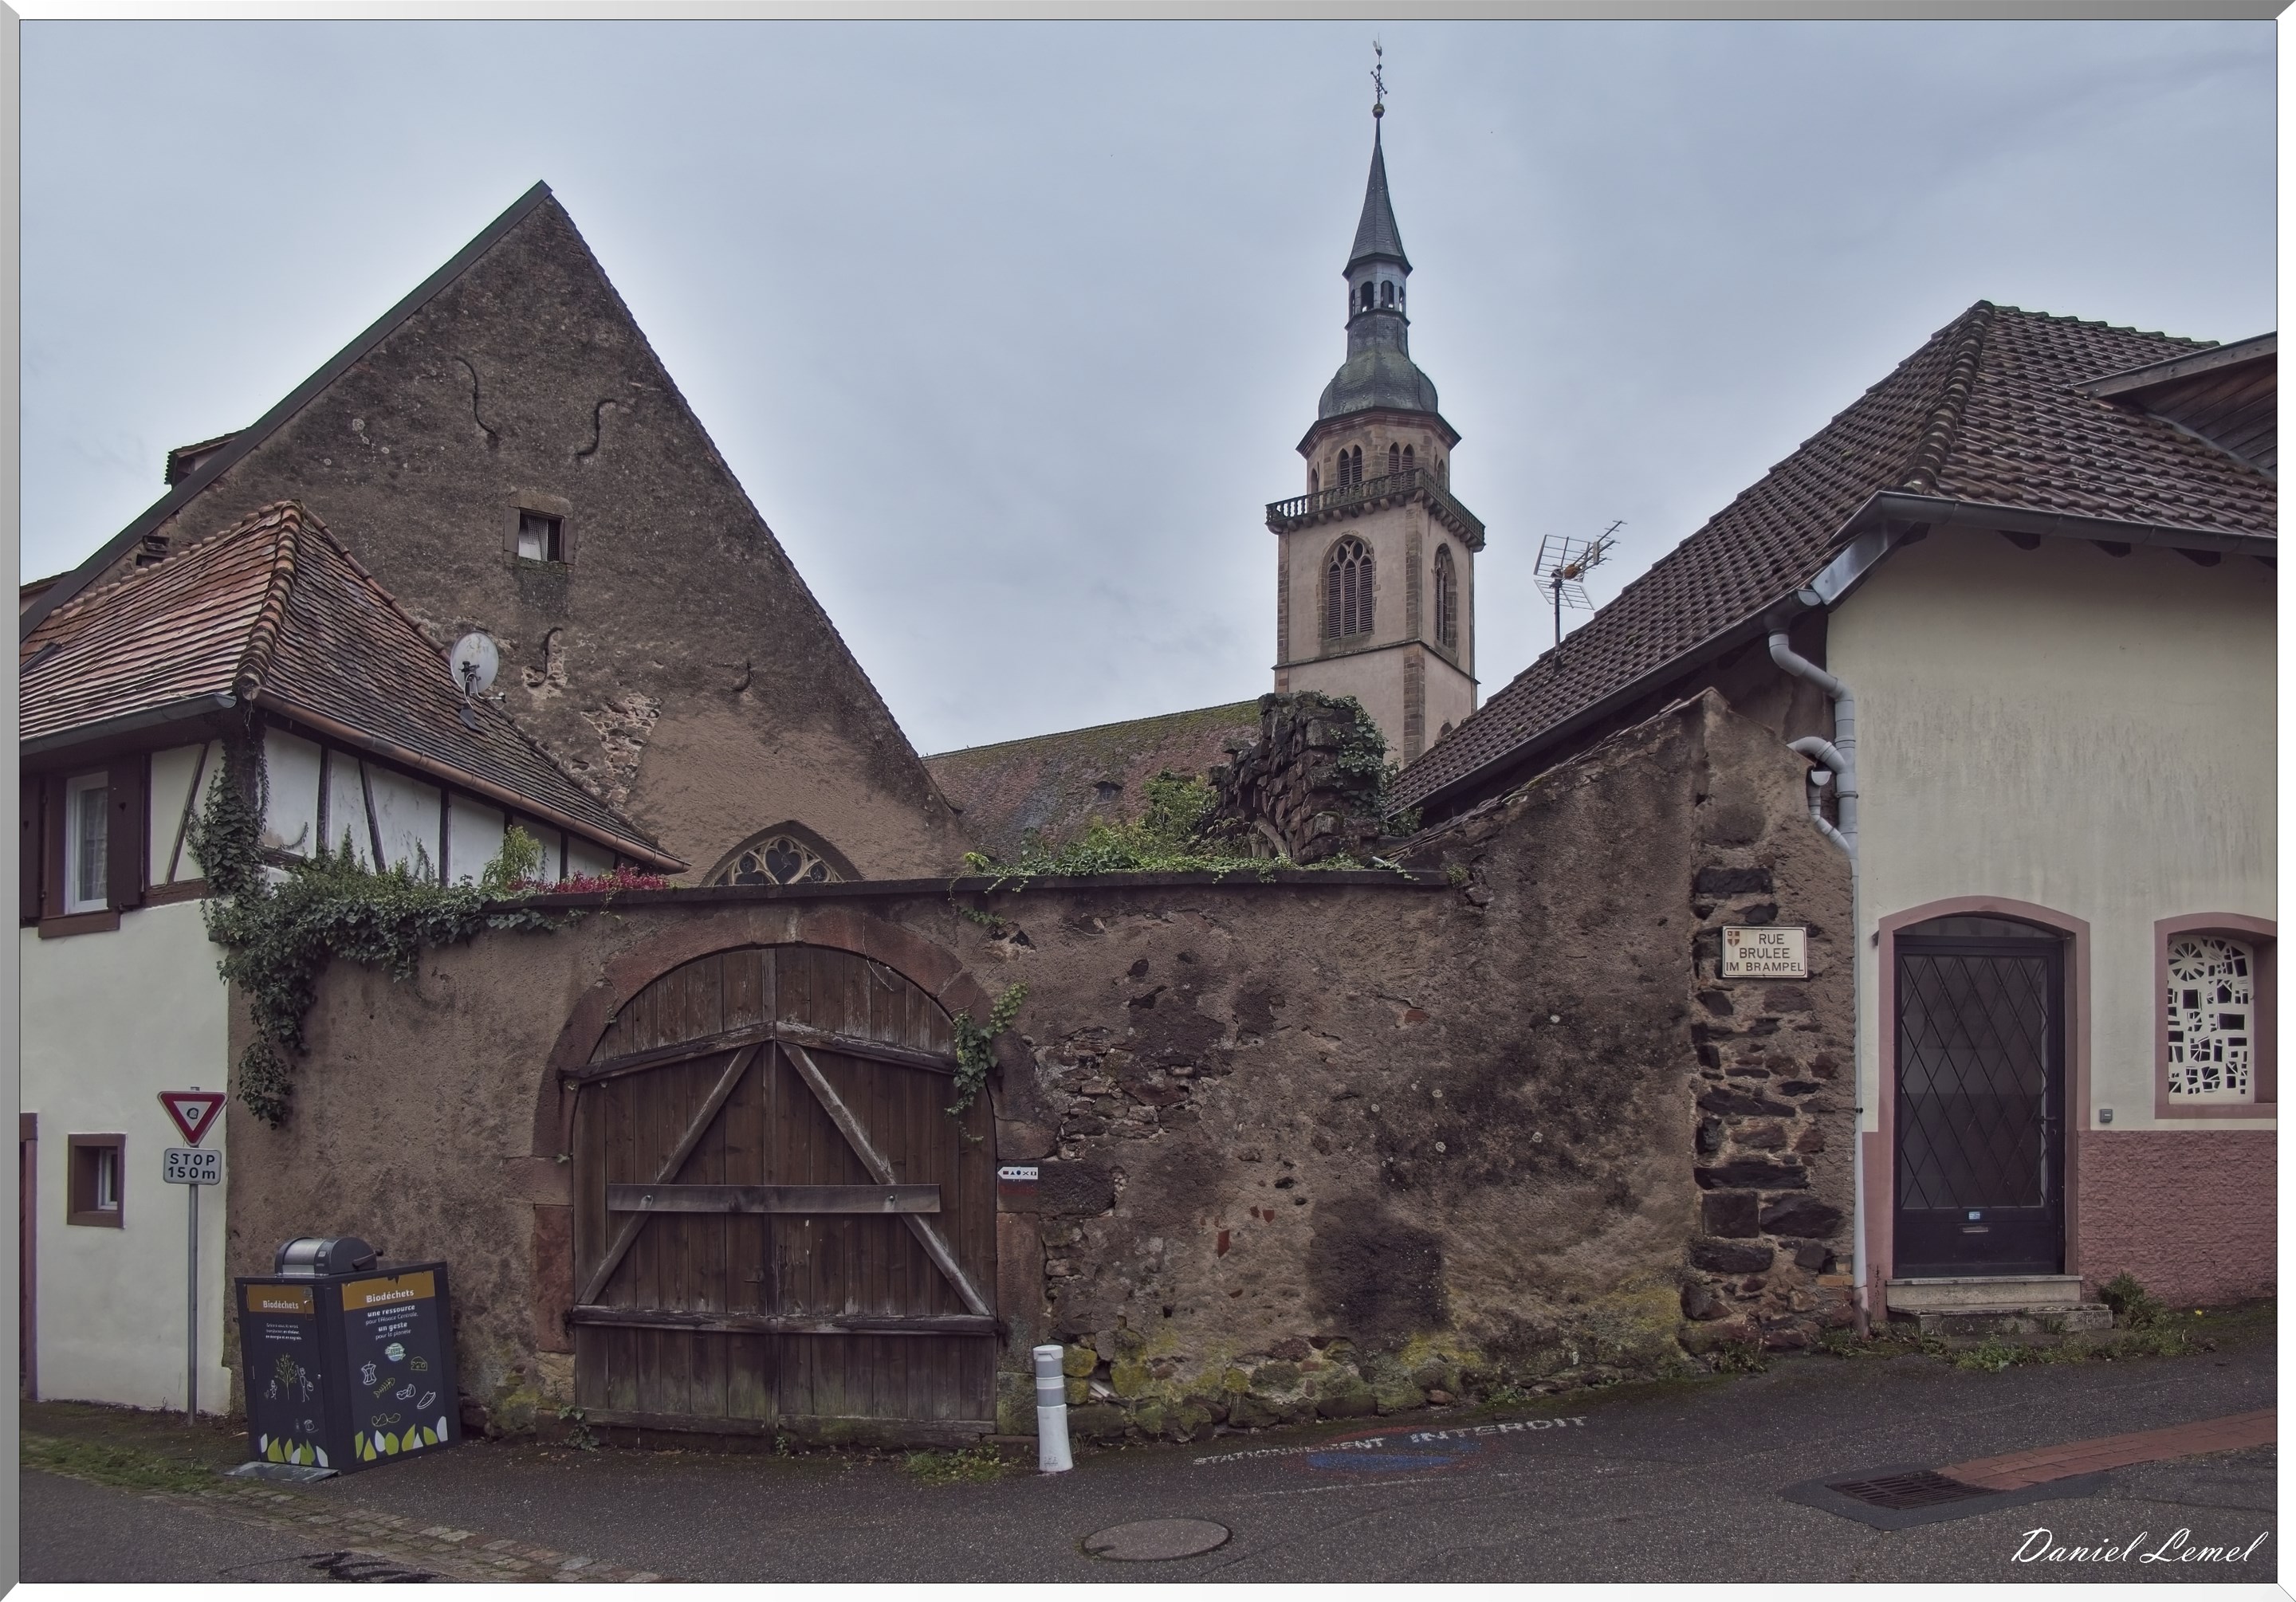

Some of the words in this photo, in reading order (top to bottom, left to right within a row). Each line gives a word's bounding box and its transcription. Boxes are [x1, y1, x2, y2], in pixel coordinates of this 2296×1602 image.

[1759, 933, 1785, 944] RUE
[1739, 948, 1791, 959] BRULEE
[1726, 962, 1740, 972] IM
[1746, 962, 1804, 972] BRAMPEL
[170, 1153, 214, 1165] STOP
[168, 1167, 216, 1180] 150m
[366, 1290, 415, 1303] Biodéchets
[262, 1300, 299, 1309] Biodéchets
[382, 1305, 415, 1315] ressource
[388, 1321, 408, 1332] geste
